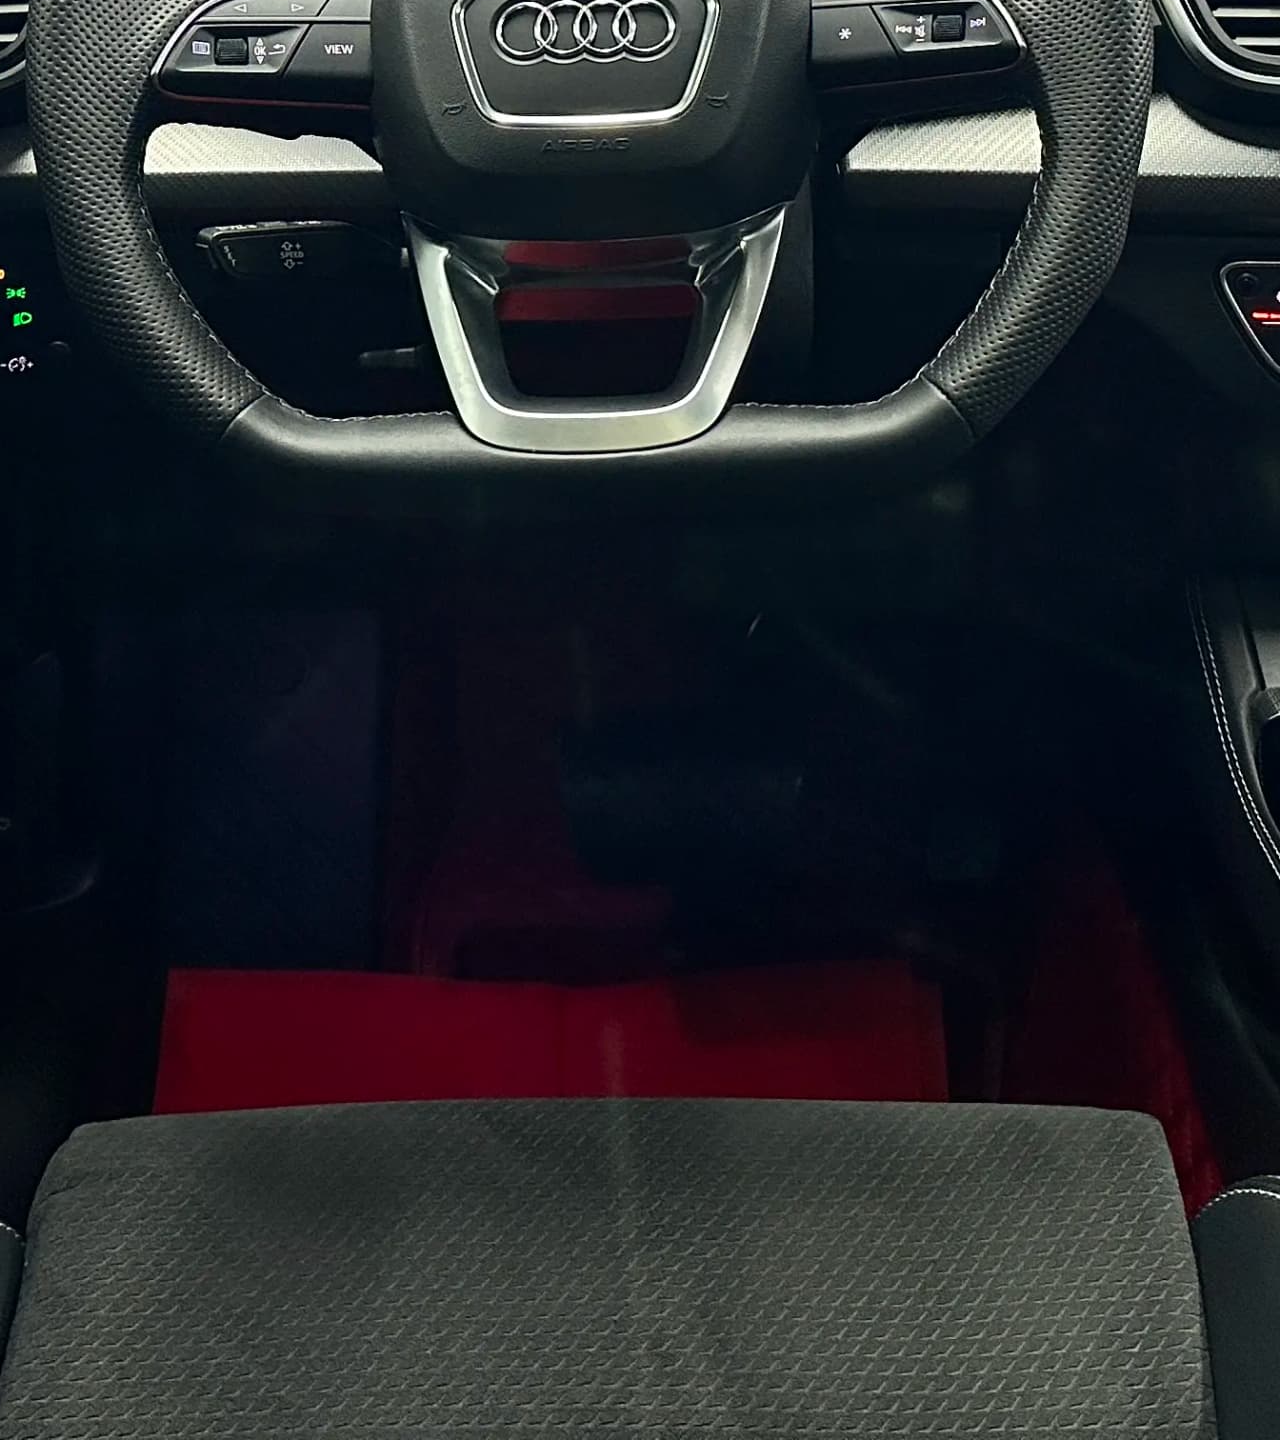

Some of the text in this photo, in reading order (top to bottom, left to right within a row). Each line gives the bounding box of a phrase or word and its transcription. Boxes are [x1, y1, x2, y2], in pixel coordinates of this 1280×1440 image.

[253, 44, 266, 56] OK
[324, 43, 354, 55] VIEW
[540, 136, 630, 154] AIRBAG
[280, 250, 305, 259] SPEED
